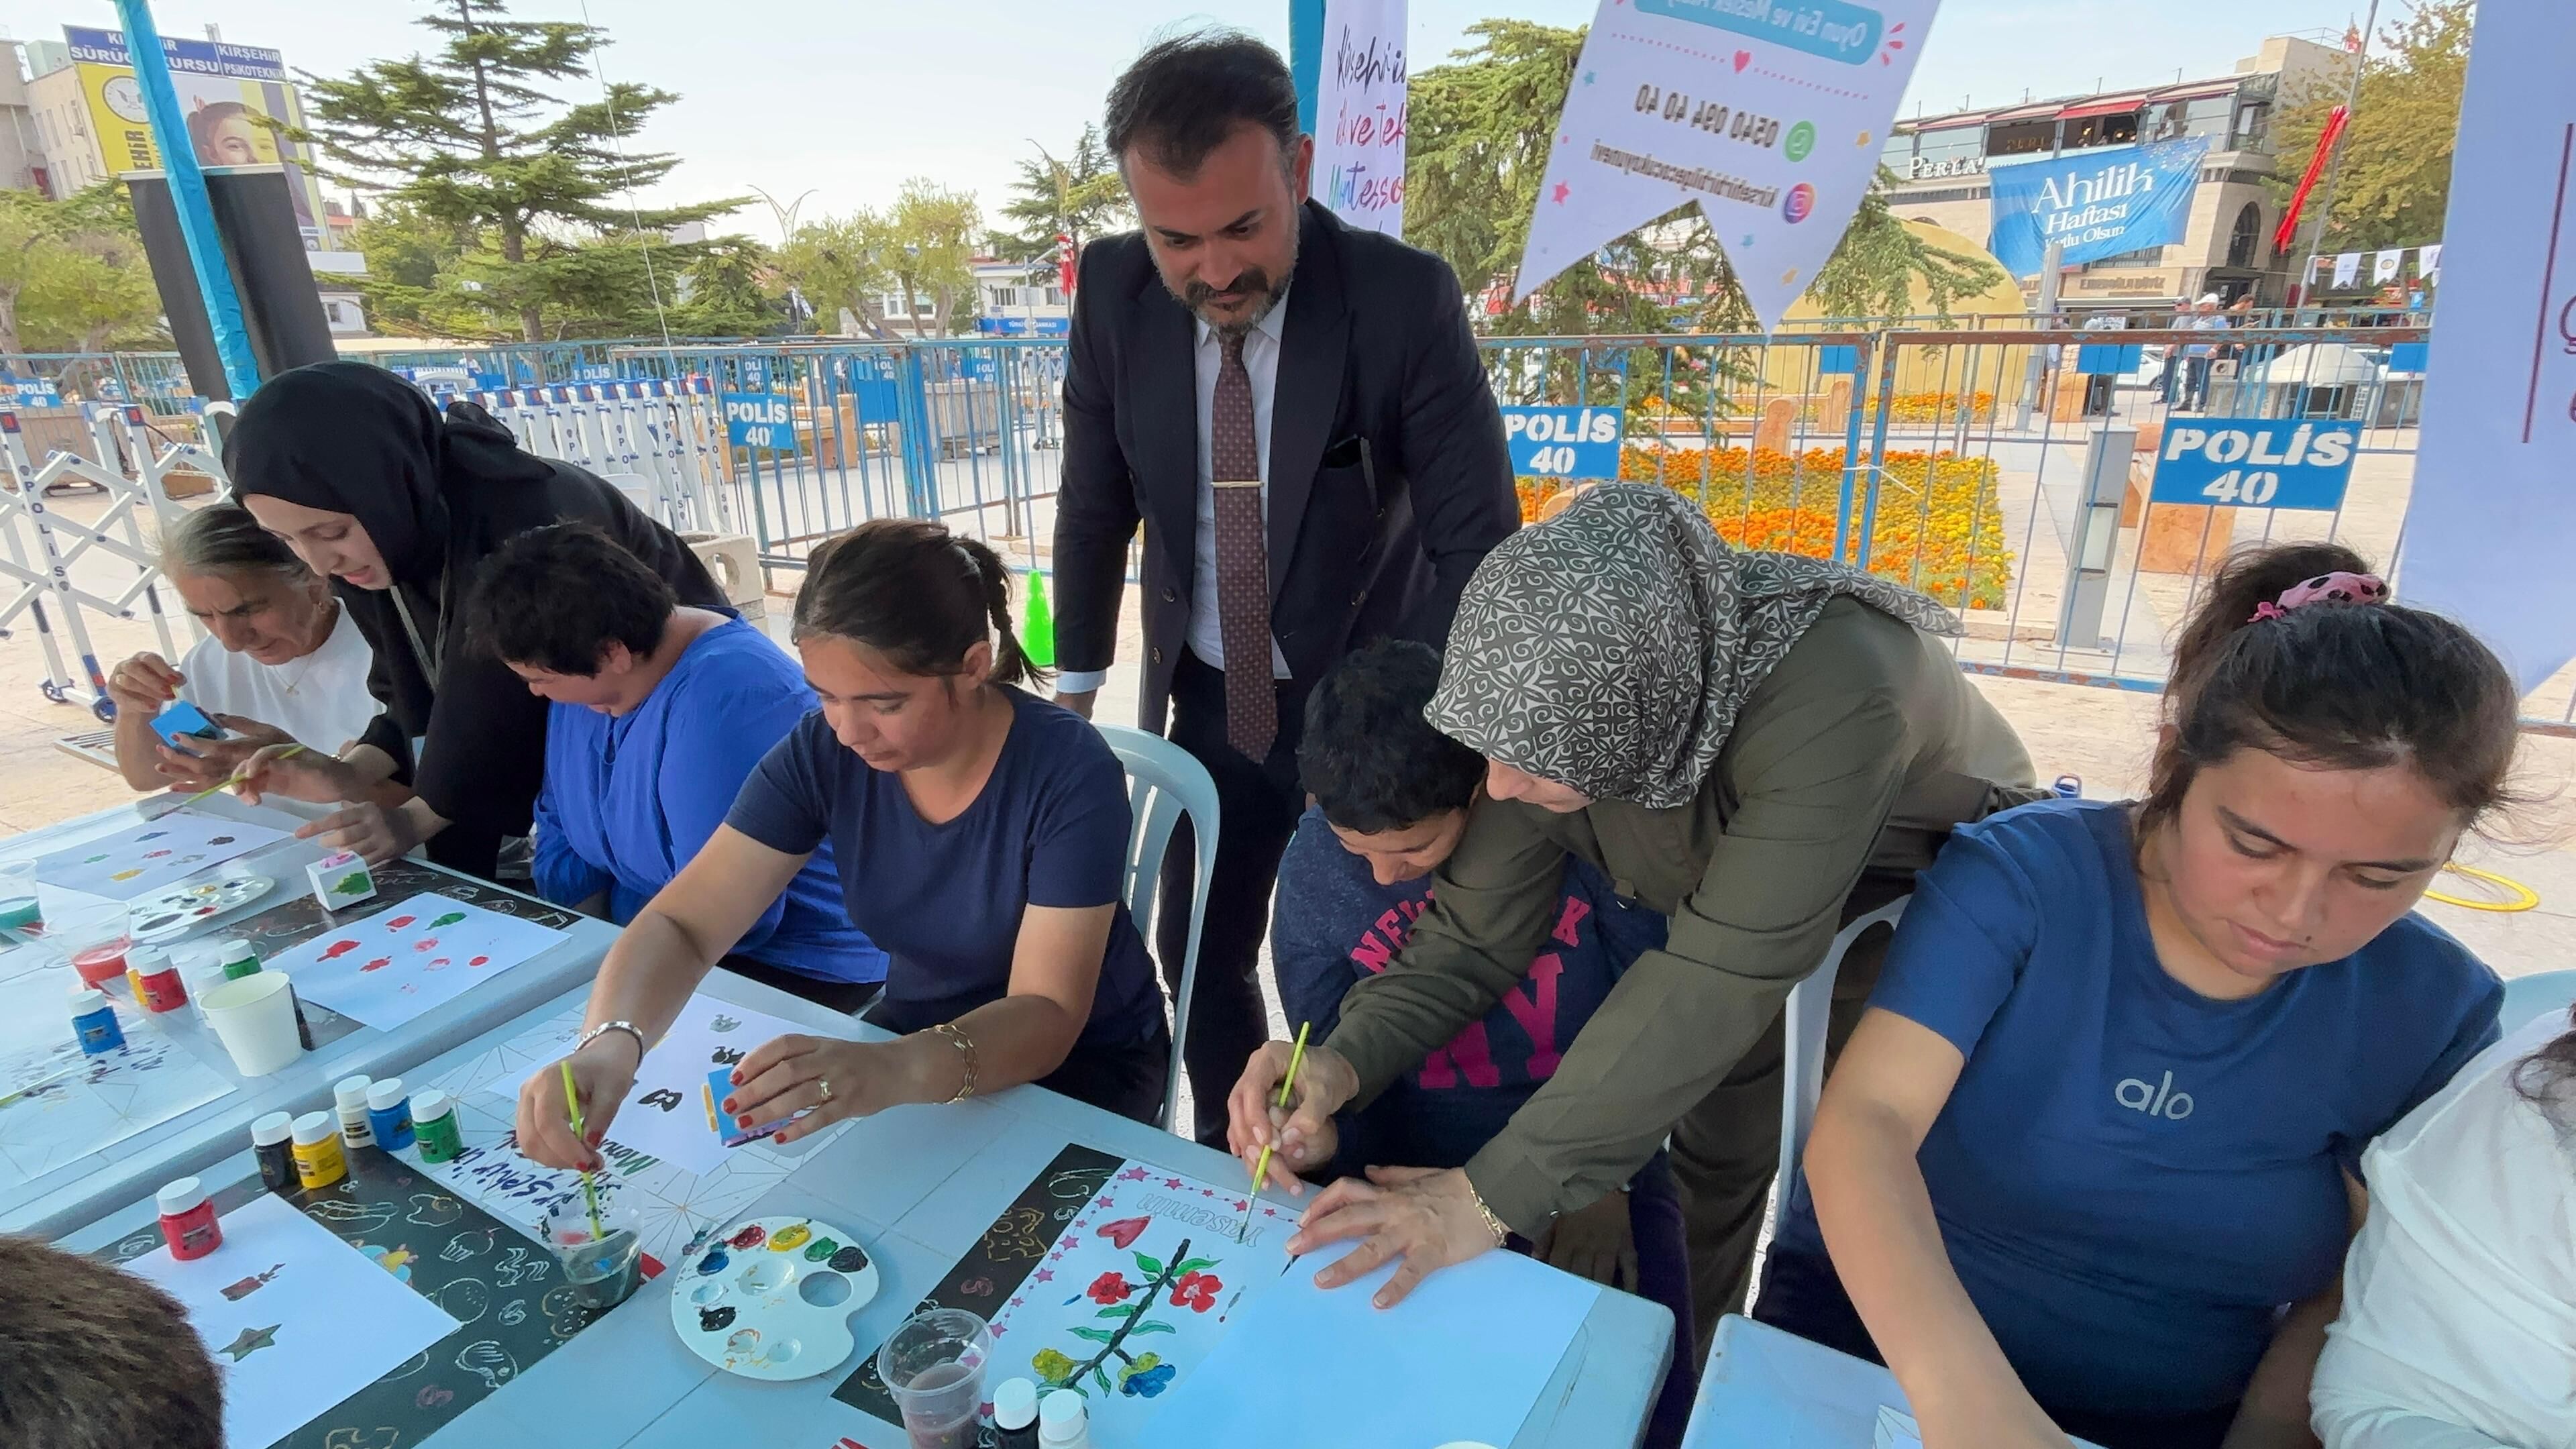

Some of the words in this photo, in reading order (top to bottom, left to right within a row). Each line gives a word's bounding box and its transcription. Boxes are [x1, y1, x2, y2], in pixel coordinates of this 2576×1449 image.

[70, 44, 132, 64] SÜRÜC
[168, 56, 219, 73] URSU
[2031, 162, 2153, 214] Ahilik
[2047, 203, 2127, 235] Haftası
[2082, 225, 2125, 243] Olsun
[747, 372, 761, 382] 40
[727, 398, 787, 424] POLİS
[745, 426, 771, 447] 40
[2164, 423, 2353, 467] POLİS
[1529, 446, 1575, 474] 40
[2202, 470, 2278, 504] 40
[2115, 1070, 2194, 1120] alo
